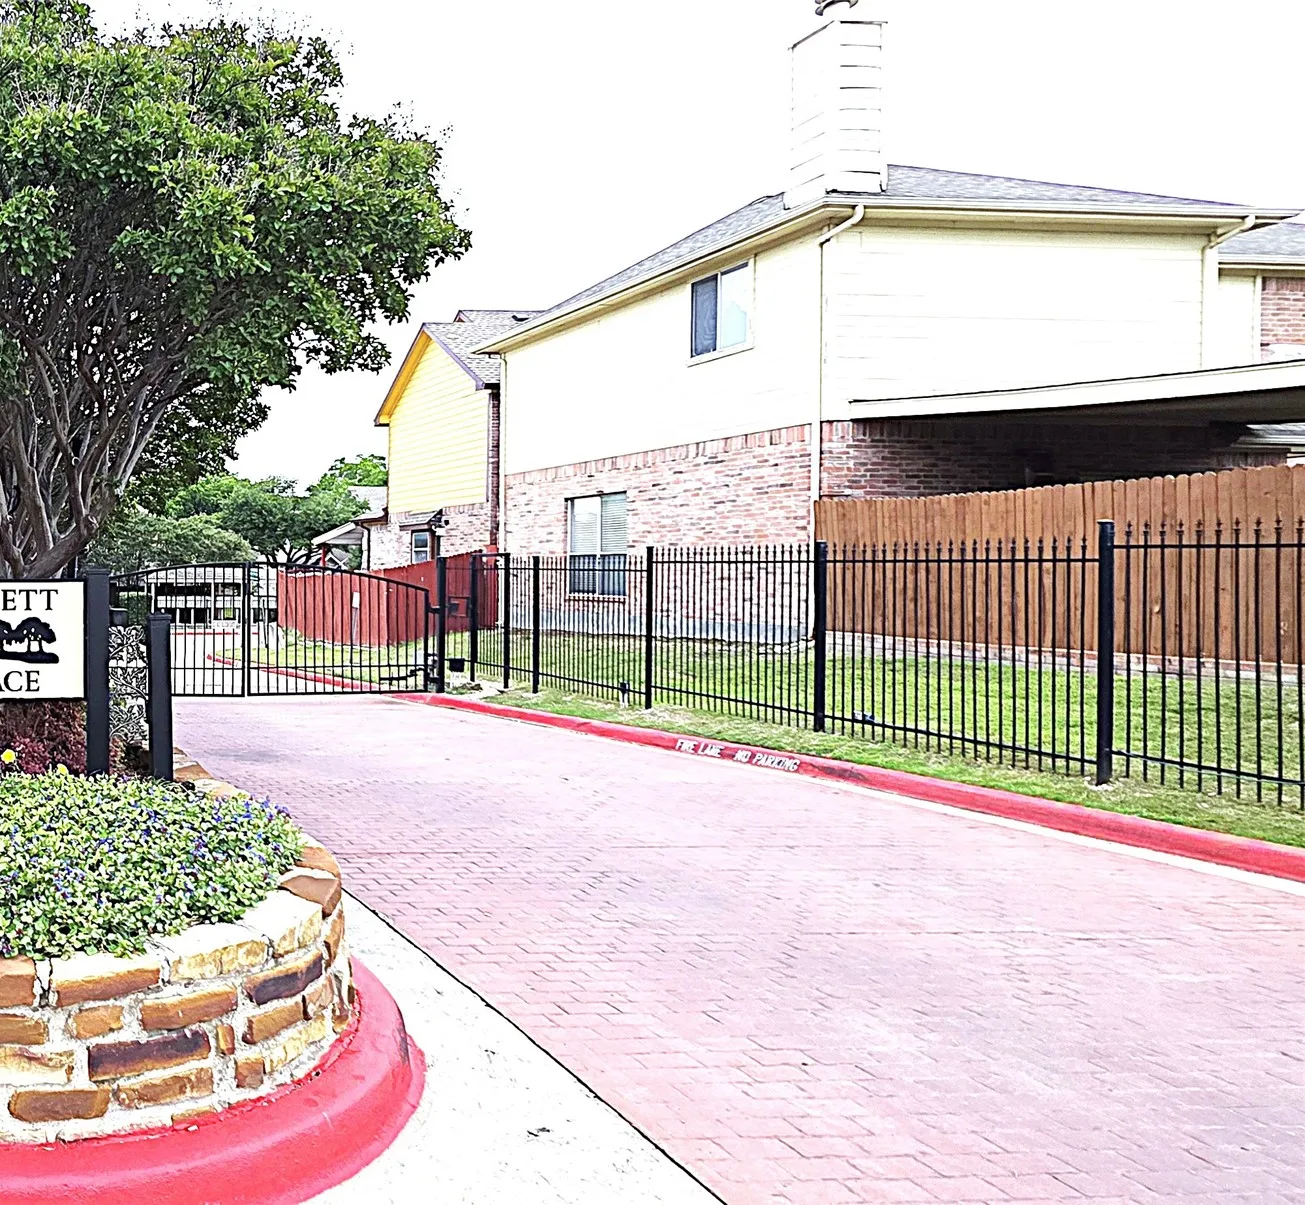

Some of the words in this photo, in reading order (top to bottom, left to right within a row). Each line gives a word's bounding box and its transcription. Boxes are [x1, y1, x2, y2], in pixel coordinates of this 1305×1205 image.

[675, 738, 698, 753] FIRE
[697, 742, 725, 758] LANE
[732, 749, 752, 763] NO
[751, 752, 801, 772] PARKING
